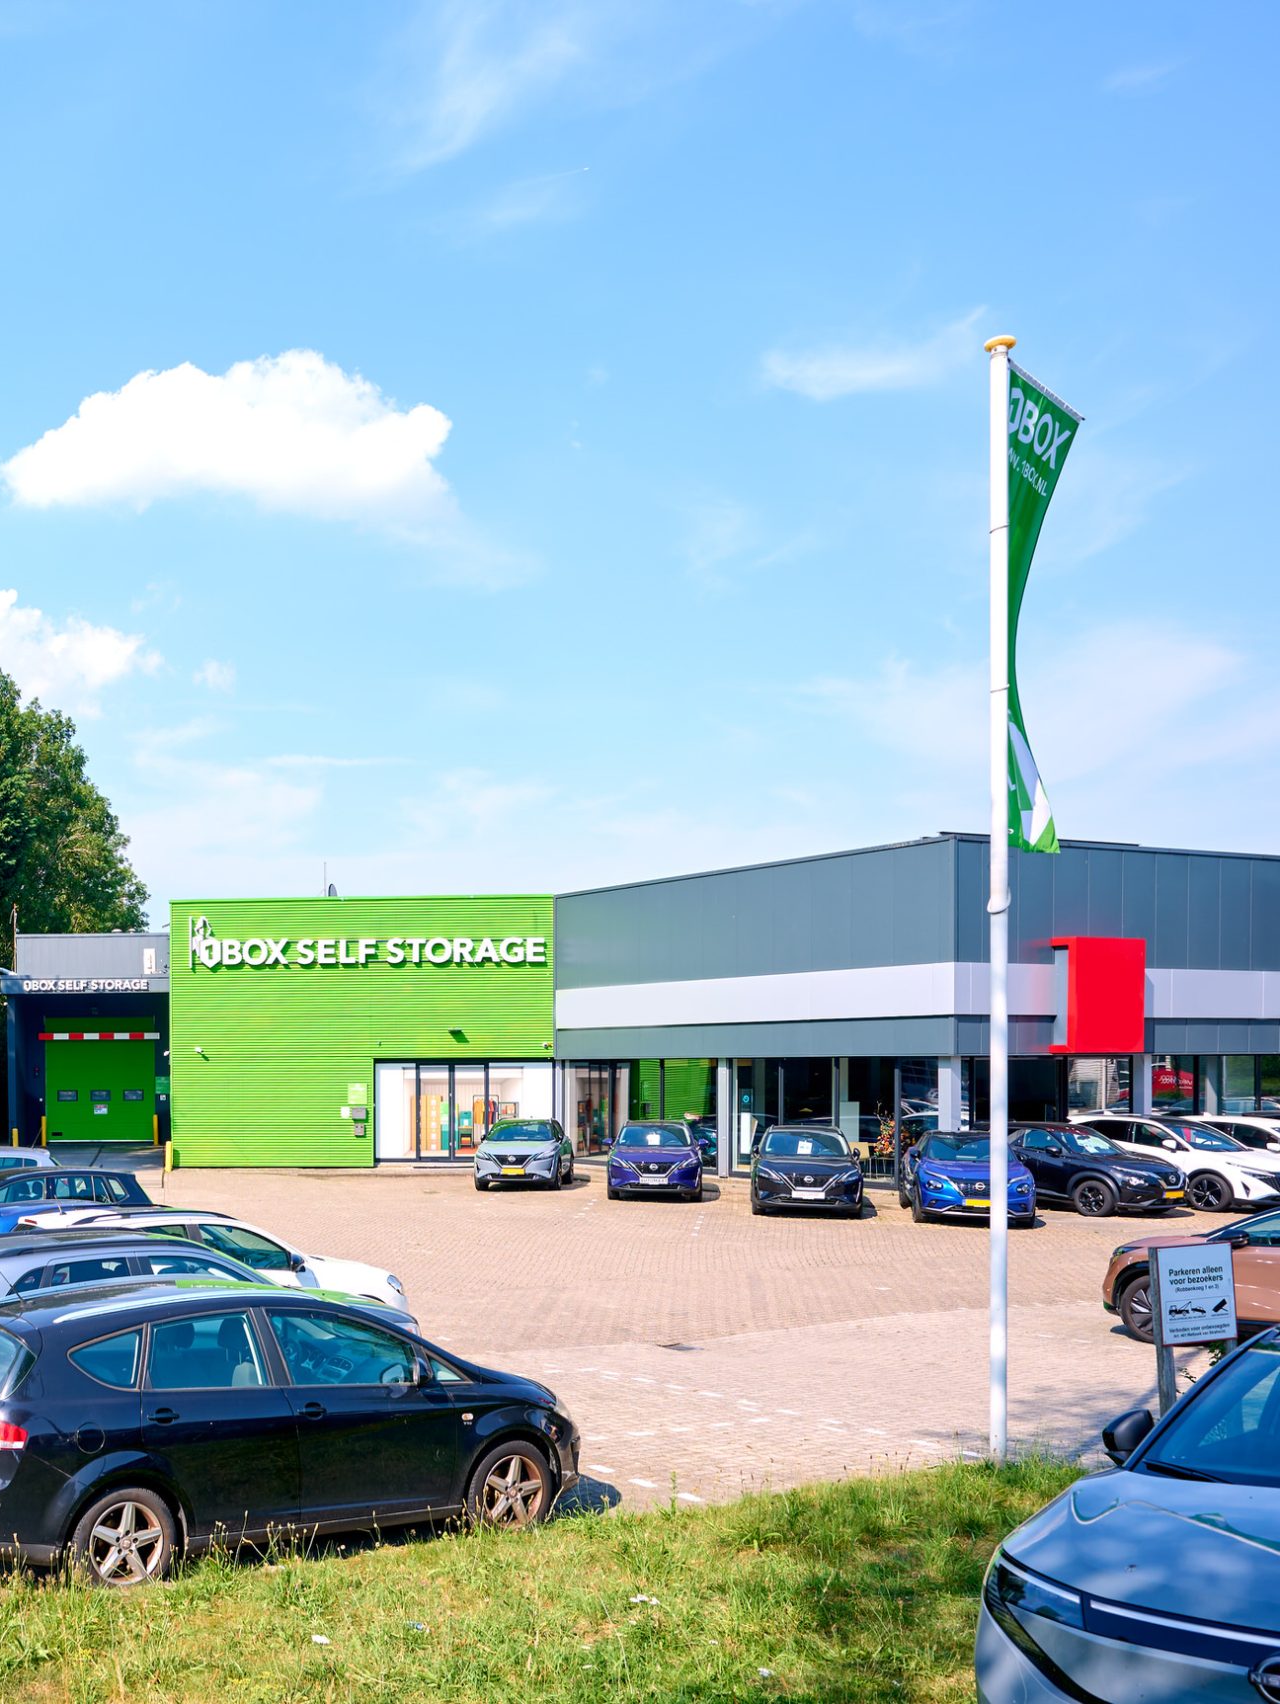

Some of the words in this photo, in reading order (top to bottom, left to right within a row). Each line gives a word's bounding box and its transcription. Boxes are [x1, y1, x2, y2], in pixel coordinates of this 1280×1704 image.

[1009, 447, 1048, 497] W.1BOX.NL
[200, 937, 292, 968] 1BOX
[296, 938, 378, 965] SELF
[385, 936, 546, 964] STORAGE
[58, 979, 87, 991] SELF
[91, 979, 148, 991] STORAGE
[1169, 1268, 1200, 1276] Parkeren
[1202, 1266, 1223, 1274] alleen
[1187, 1274, 1223, 1284] bezoekers
